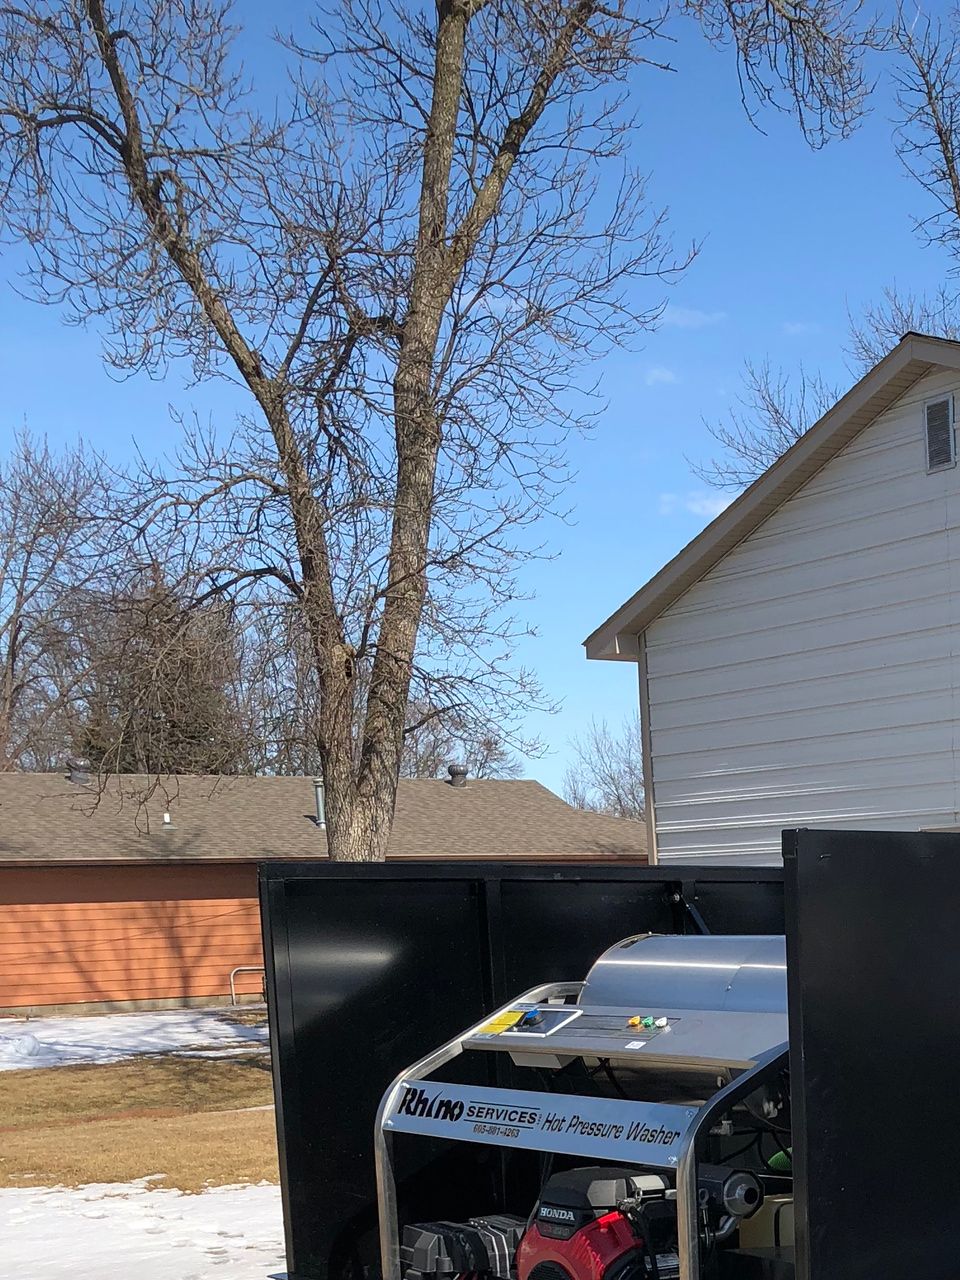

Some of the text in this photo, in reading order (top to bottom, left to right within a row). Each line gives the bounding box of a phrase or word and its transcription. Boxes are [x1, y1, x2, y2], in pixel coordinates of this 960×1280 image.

[398, 1087, 464, 1122] Rhino
[466, 1106, 538, 1125] SERVICES
[541, 1112, 566, 1132] Hot
[565, 1115, 624, 1139] Pressure
[626, 1121, 680, 1146] Washer
[540, 1207, 575, 1220] HONDA
